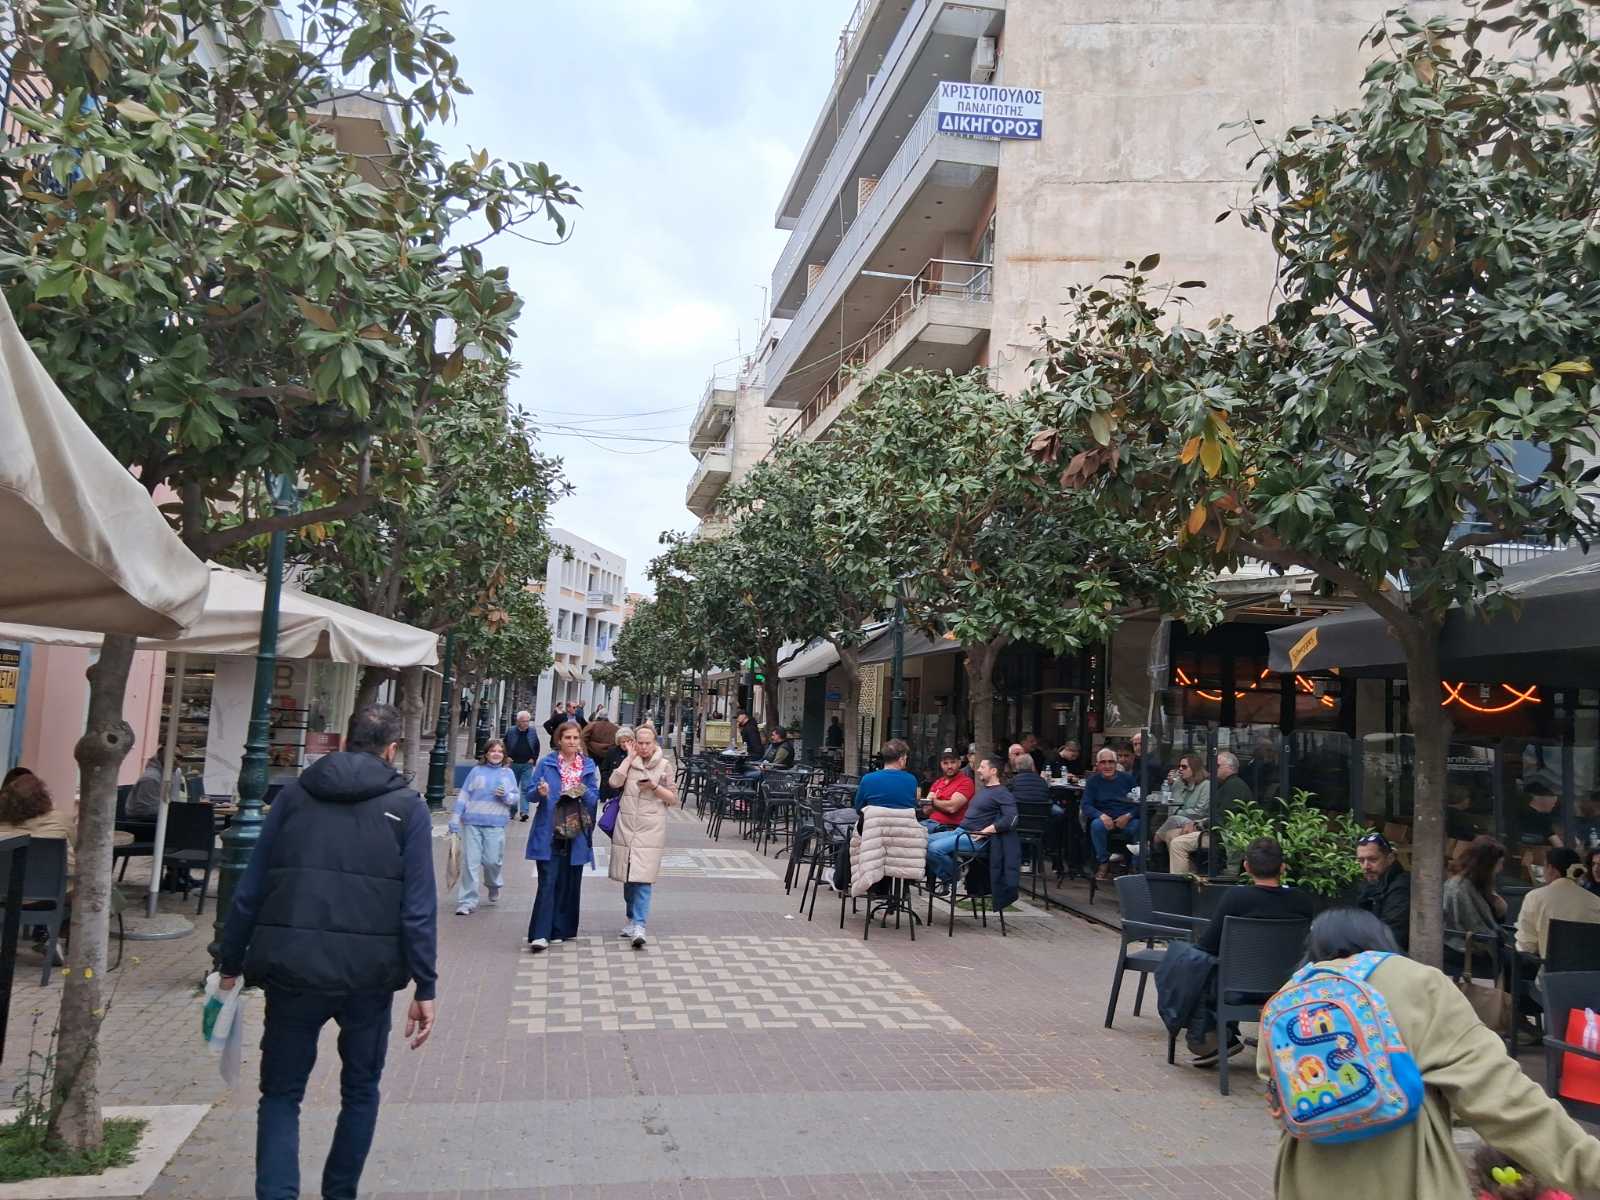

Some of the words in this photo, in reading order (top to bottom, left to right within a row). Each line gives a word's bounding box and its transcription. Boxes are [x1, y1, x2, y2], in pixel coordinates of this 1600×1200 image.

[941, 83, 1042, 105] ΧΡΙΣΤΟΠΟΥΛΟΣ
[957, 101, 1024, 117] ΠΑΝΑΓΙΩΤΗΣ
[941, 115, 1038, 137] ΔΙΚΗΓΟΡΟΣ
